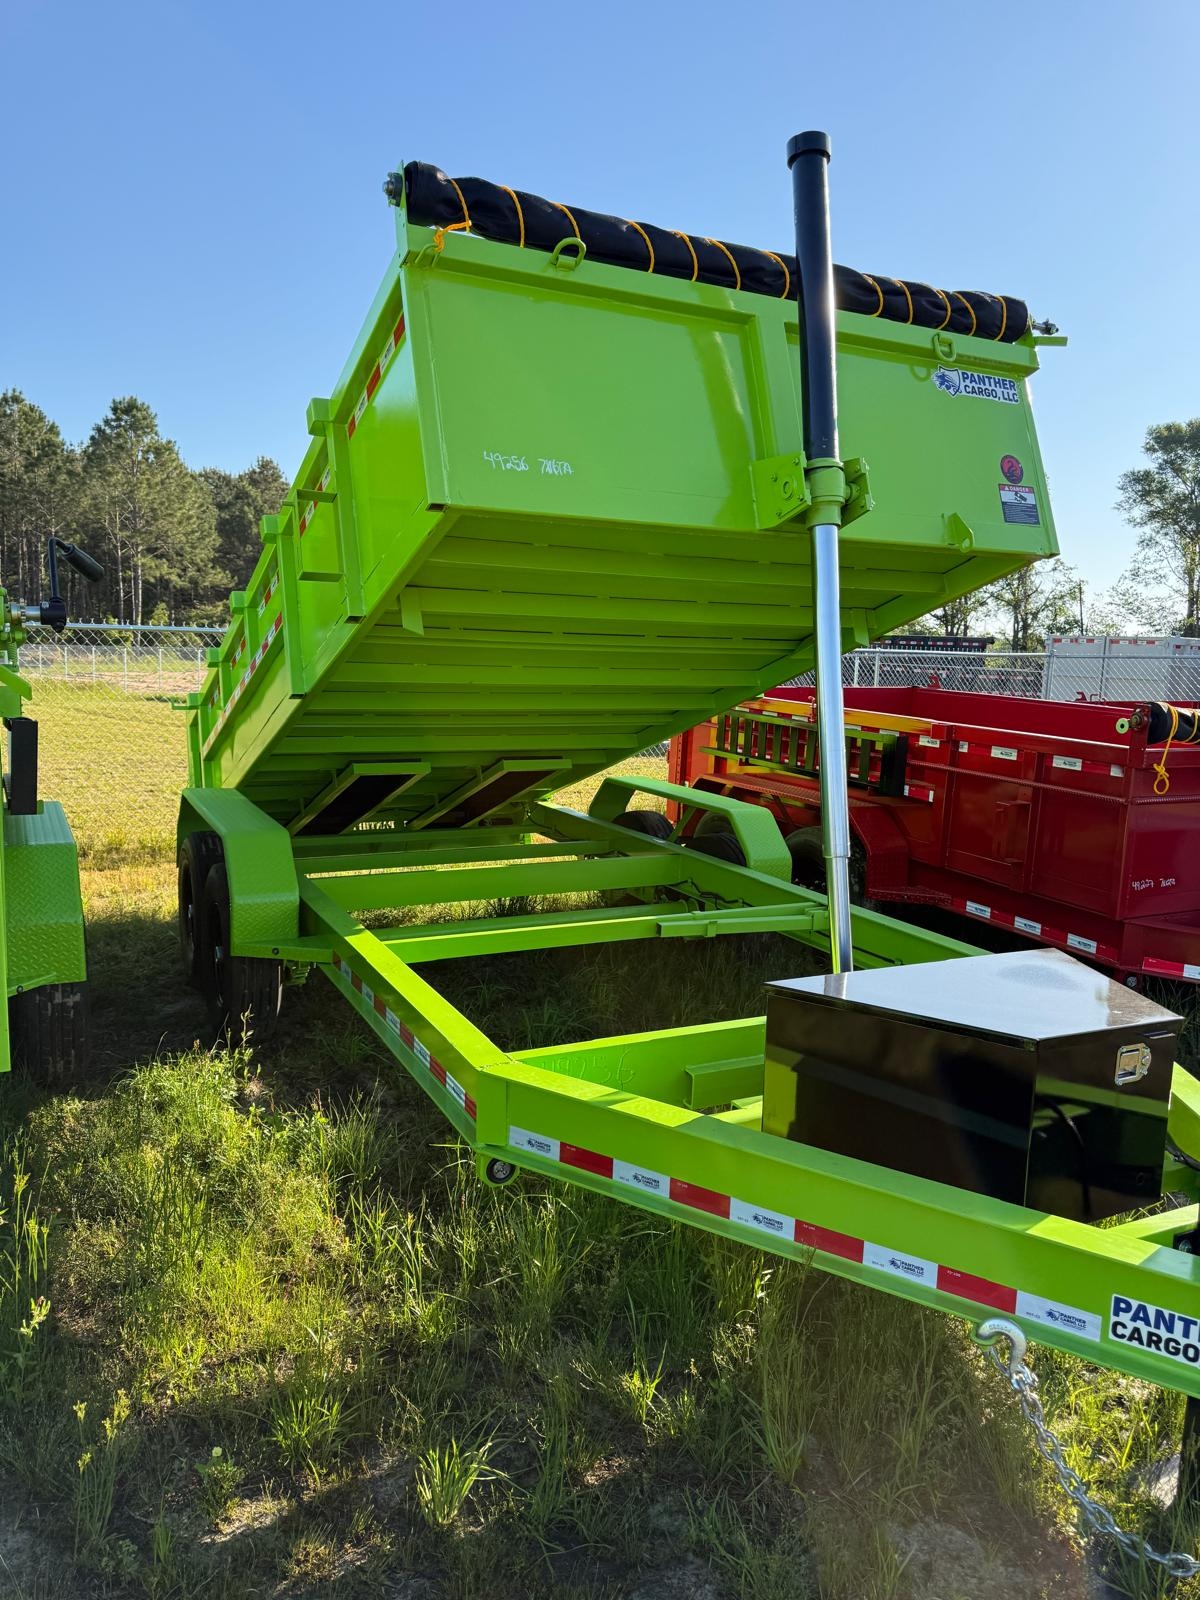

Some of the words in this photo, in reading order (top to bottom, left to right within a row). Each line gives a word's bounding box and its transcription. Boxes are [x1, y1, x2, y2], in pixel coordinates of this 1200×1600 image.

[962, 371, 1016, 392] PANTHER
[964, 384, 1001, 401] CARGO,
[1001, 391, 1019, 403] LLC
[901, 1261, 924, 1272] PANTHER
[1060, 1314, 1086, 1324] PANTHER
[1112, 1296, 1200, 1342] PANT
